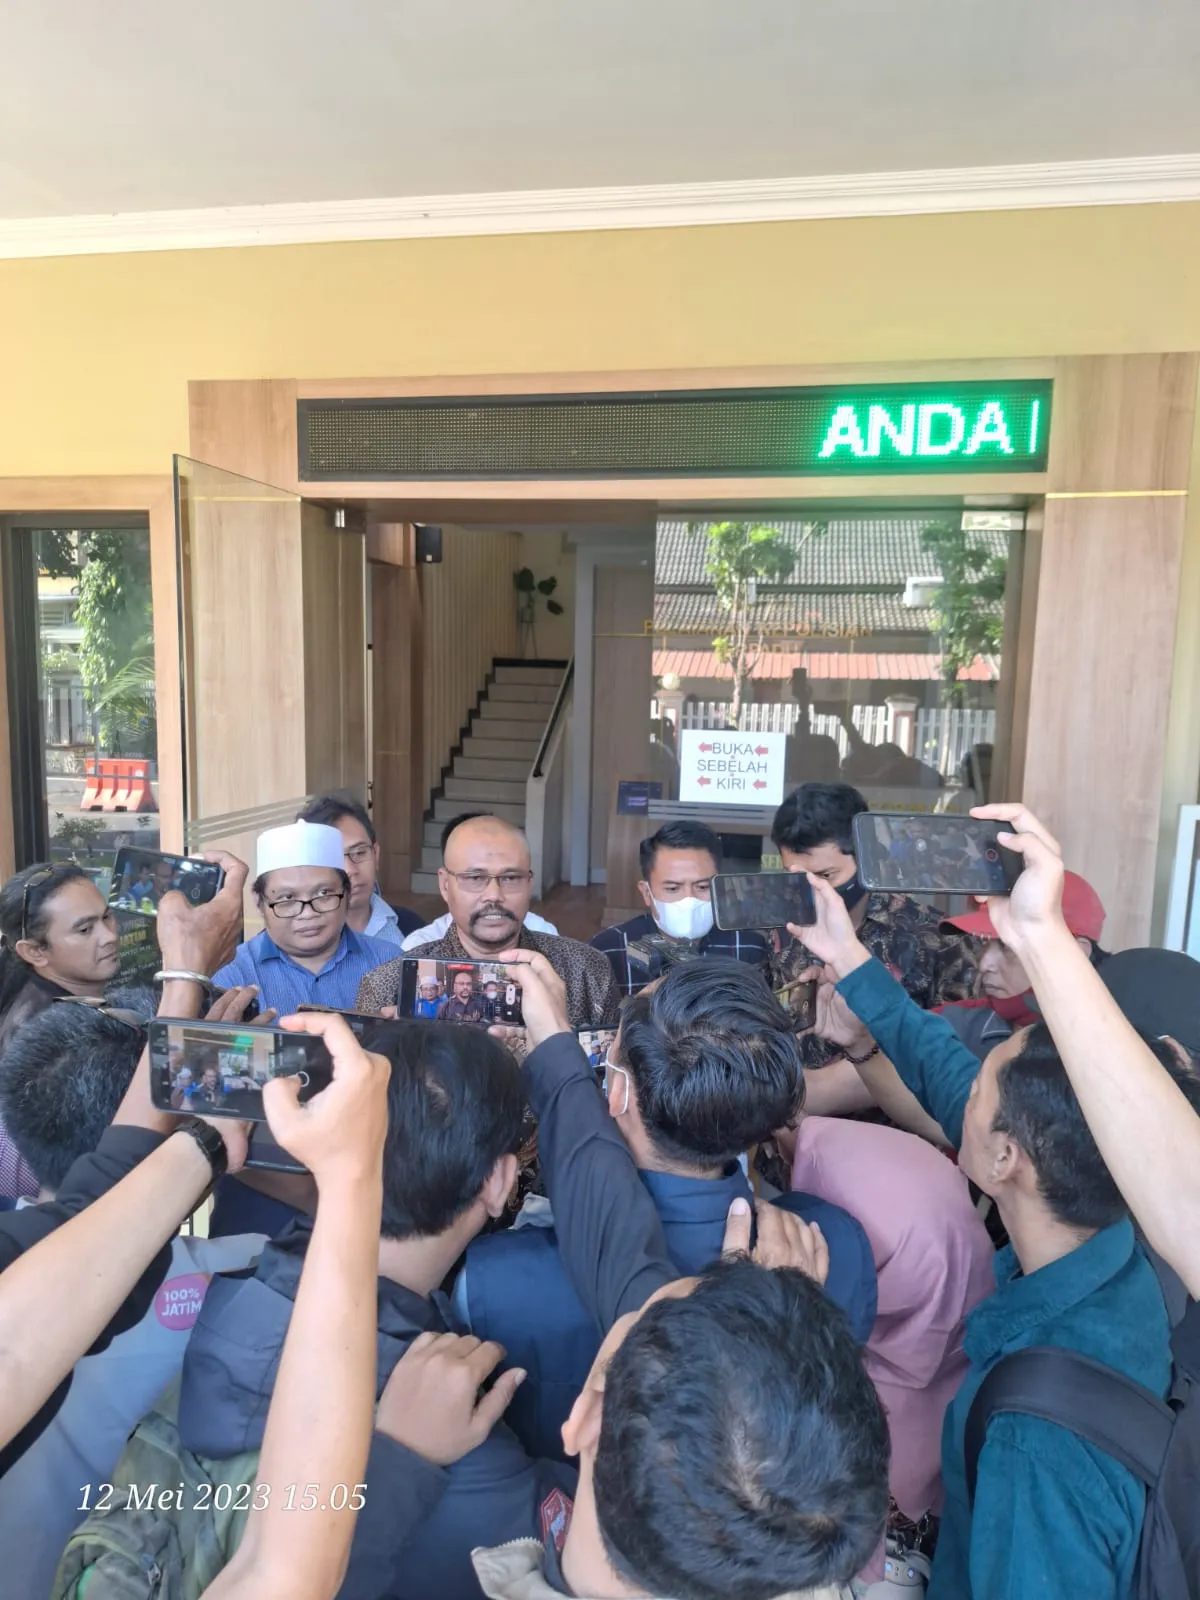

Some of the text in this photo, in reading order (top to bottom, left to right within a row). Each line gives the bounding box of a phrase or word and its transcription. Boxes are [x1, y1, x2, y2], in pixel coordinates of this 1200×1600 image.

[818, 401, 1015, 458] ANDA
[711, 742, 754, 755] BUKA
[697, 759, 768, 774] SEBELAH
[716, 777, 746, 790] KIRI
[163, 1287, 201, 1303] 100%
[161, 1299, 203, 1317] JATIM
